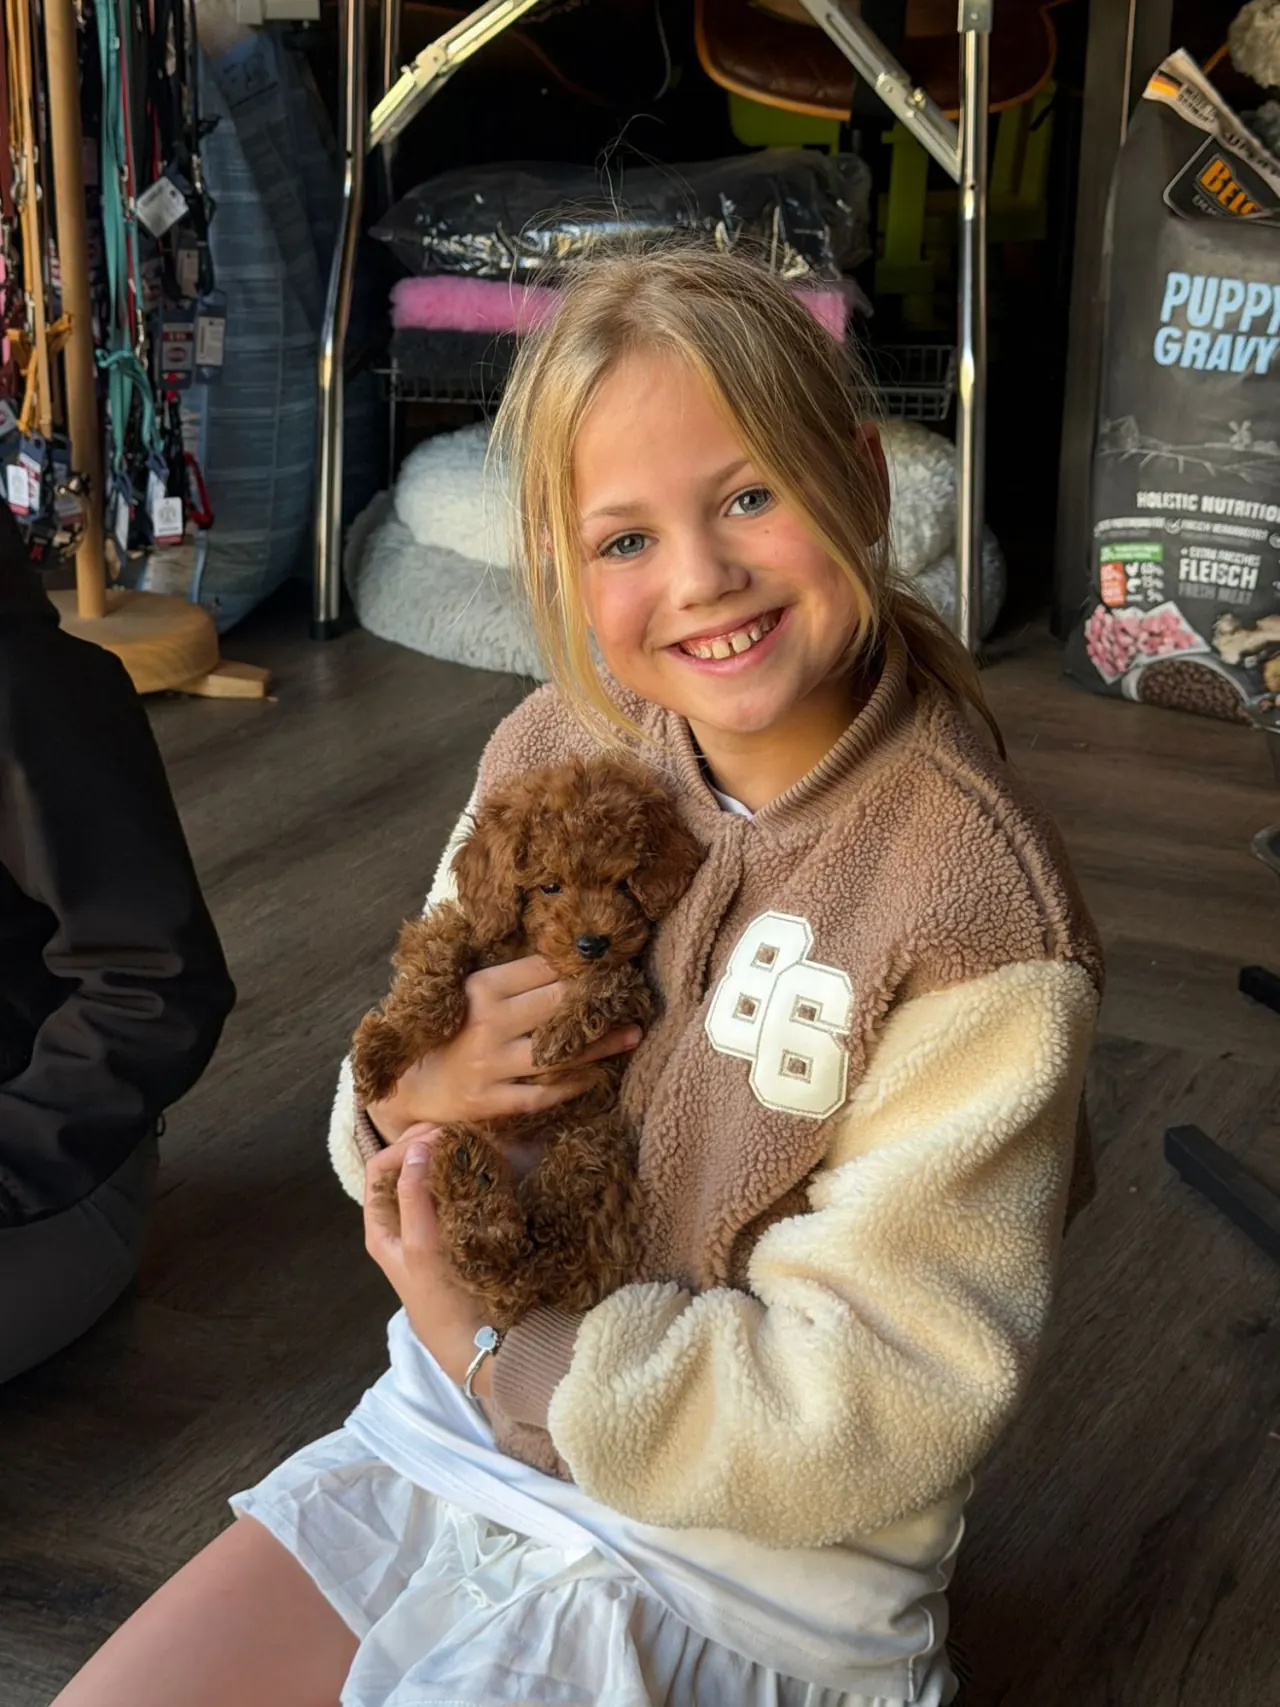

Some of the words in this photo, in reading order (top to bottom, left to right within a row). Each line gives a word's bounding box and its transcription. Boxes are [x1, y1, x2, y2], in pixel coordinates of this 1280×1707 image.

[1153, 326, 1280, 375] GRAVY
[1200, 495, 1280, 523] NUTRITIO
[1179, 558, 1259, 590] FLEISCH
